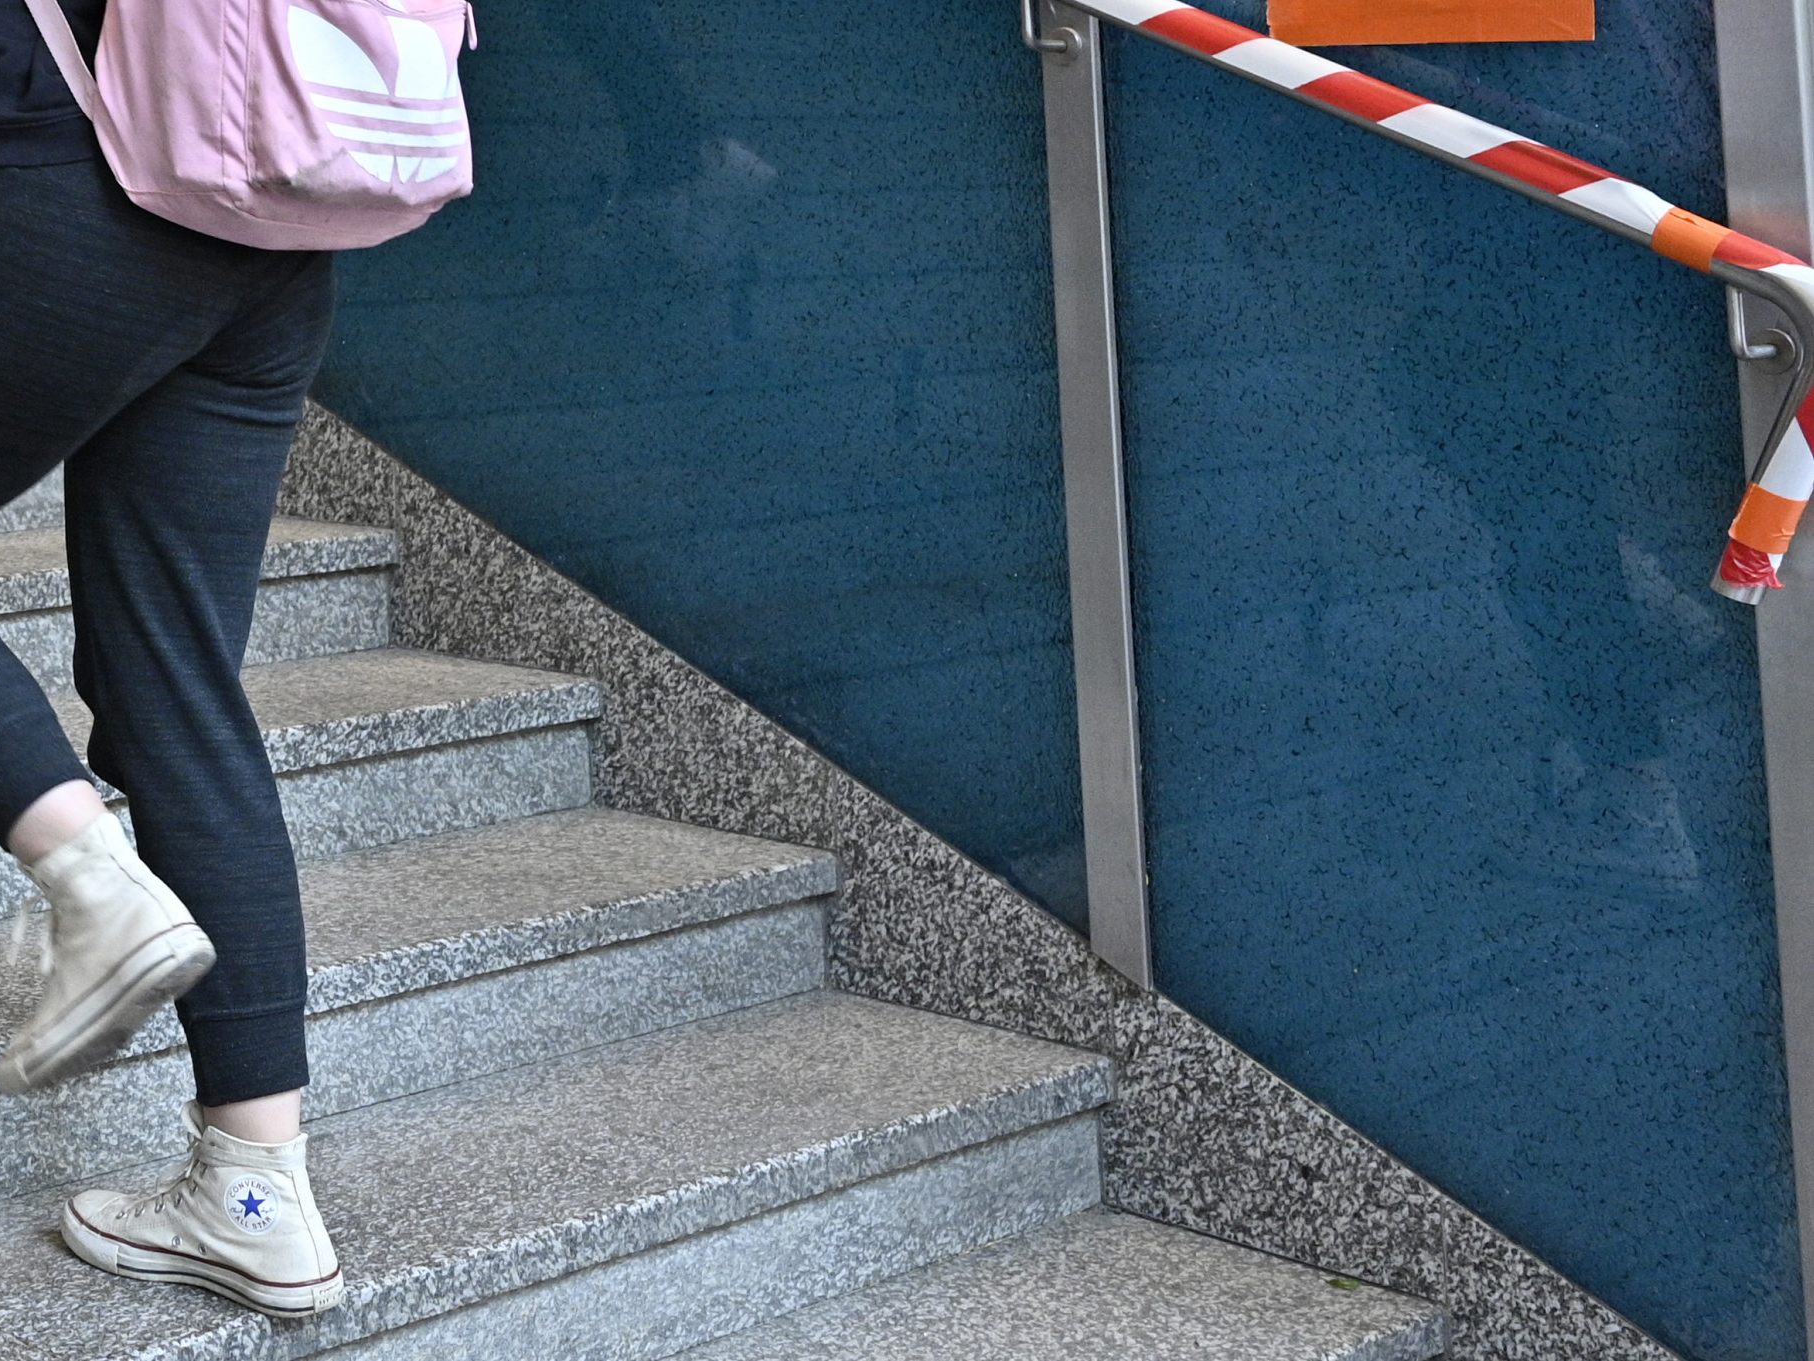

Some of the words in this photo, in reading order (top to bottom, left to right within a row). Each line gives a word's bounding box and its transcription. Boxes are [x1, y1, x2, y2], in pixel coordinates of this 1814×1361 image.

[229, 1179, 271, 1198] CONVERSE
[235, 1215, 249, 1228] ALL
[251, 1216, 272, 1229] STAR
